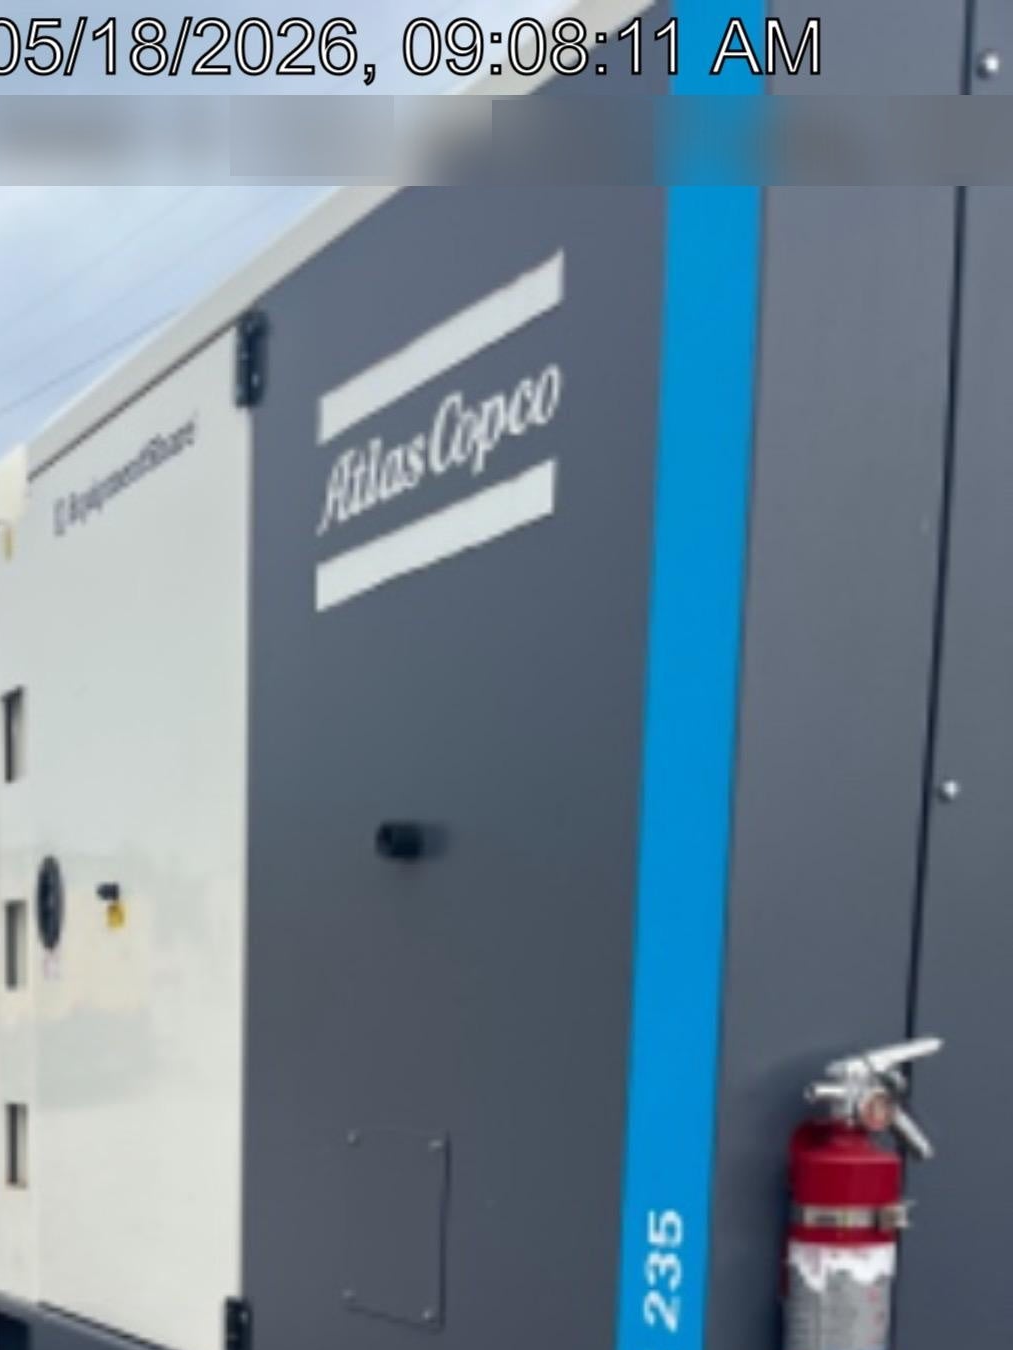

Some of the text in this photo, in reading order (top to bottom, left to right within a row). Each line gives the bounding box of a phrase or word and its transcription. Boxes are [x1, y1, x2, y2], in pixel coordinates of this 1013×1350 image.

[317, 362, 564, 537] Atlas Copco
[643, 1208, 683, 1334] 235
